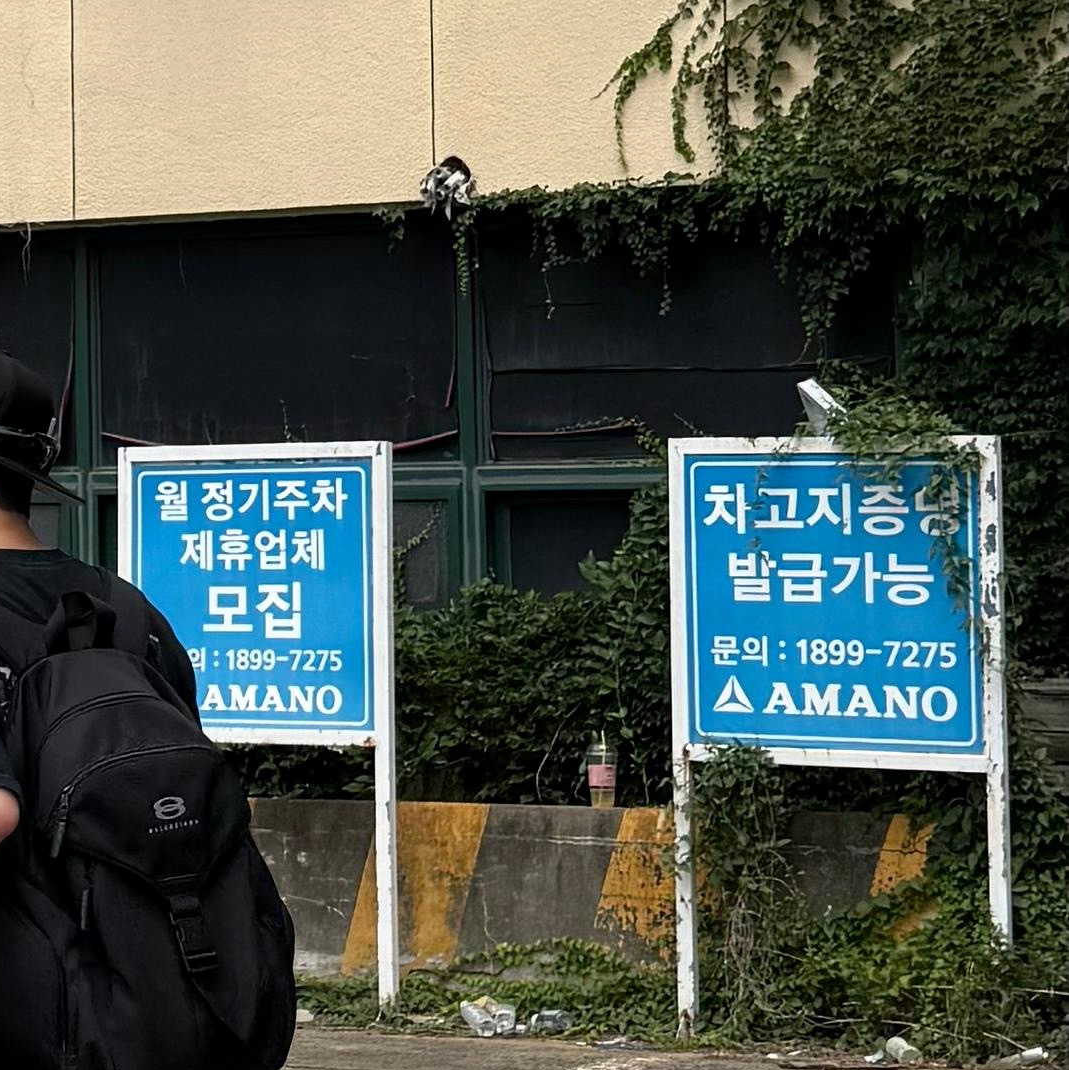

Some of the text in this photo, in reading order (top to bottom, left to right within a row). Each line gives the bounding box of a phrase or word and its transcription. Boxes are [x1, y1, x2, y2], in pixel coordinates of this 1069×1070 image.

[155, 478, 348, 521] 월 정기주차
[703, 483, 959, 536] 차고지증명
[180, 529, 325, 571] 제휴업체
[728, 551, 934, 606] 발급가능
[202, 581, 302, 639] 모집
[226, 649, 342, 671] 1899-7275
[796, 639, 957, 668] 1899-7275
[200, 684, 343, 715] AMANO
[763, 682, 958, 722] AMANO
